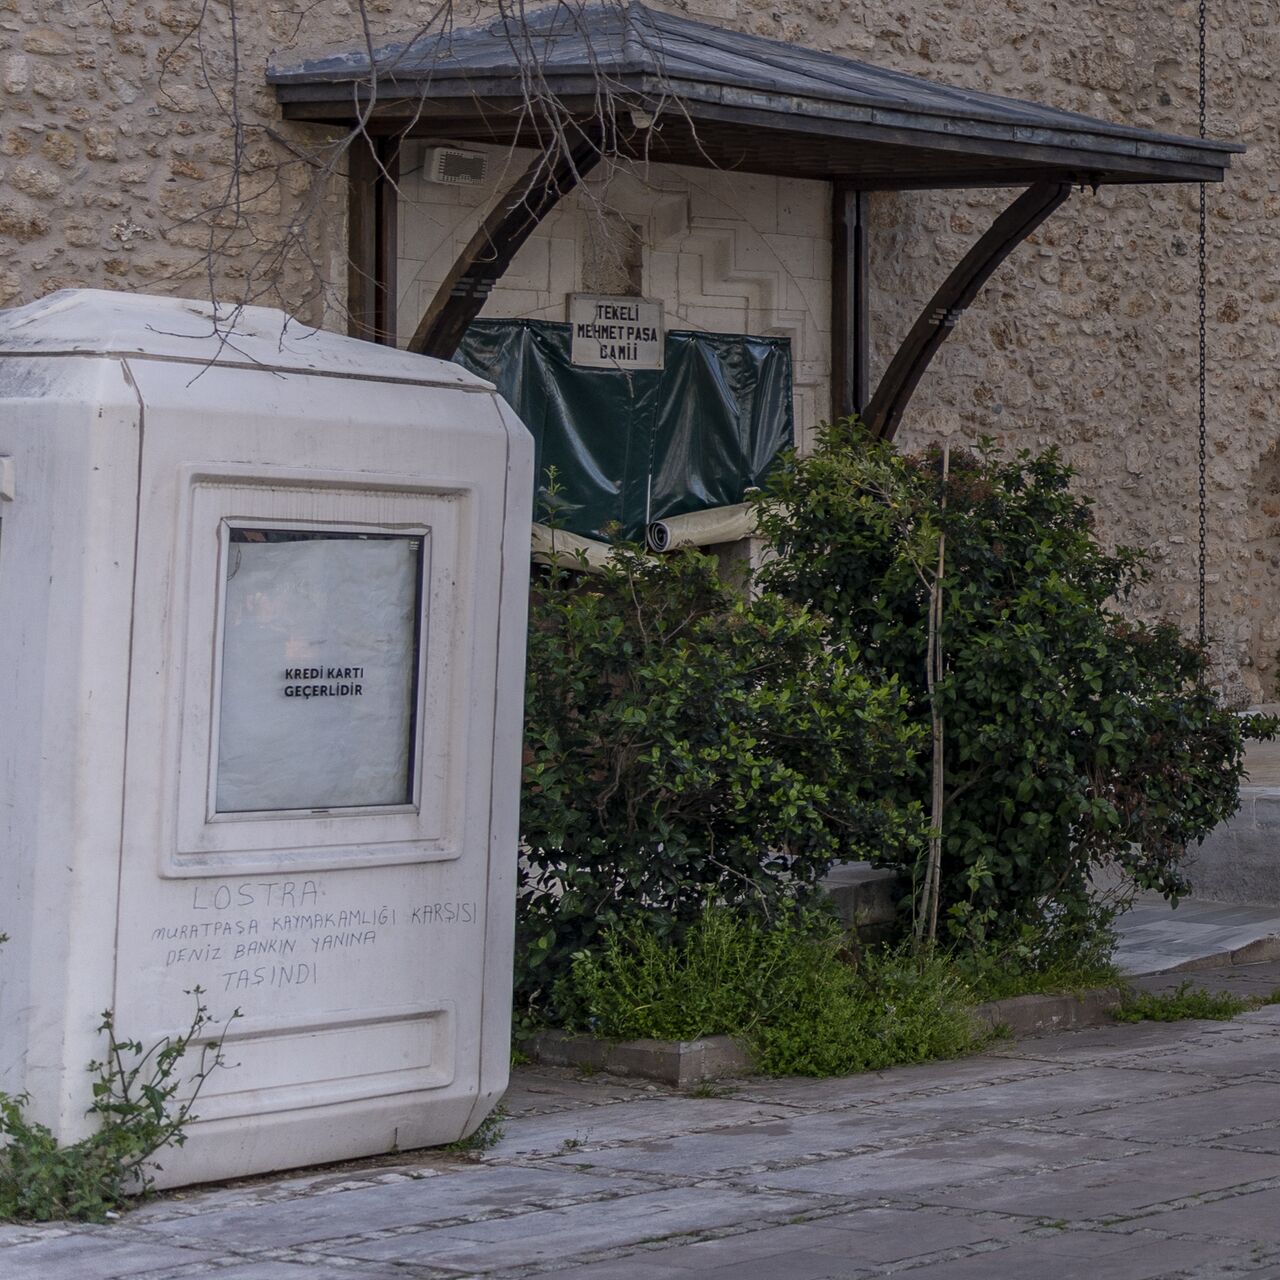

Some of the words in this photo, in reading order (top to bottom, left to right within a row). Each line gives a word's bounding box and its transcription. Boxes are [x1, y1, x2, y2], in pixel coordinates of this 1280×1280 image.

[598, 304, 639, 321] TEKELİ
[577, 324, 624, 339] MEHMET
[627, 326, 657, 342] PAŞA
[285, 665, 324, 680] KREDİ
[327, 667, 364, 679] KARTI
[284, 681, 363, 700] GEÇERLİDİR
[311, 930, 376, 953] YANINA
